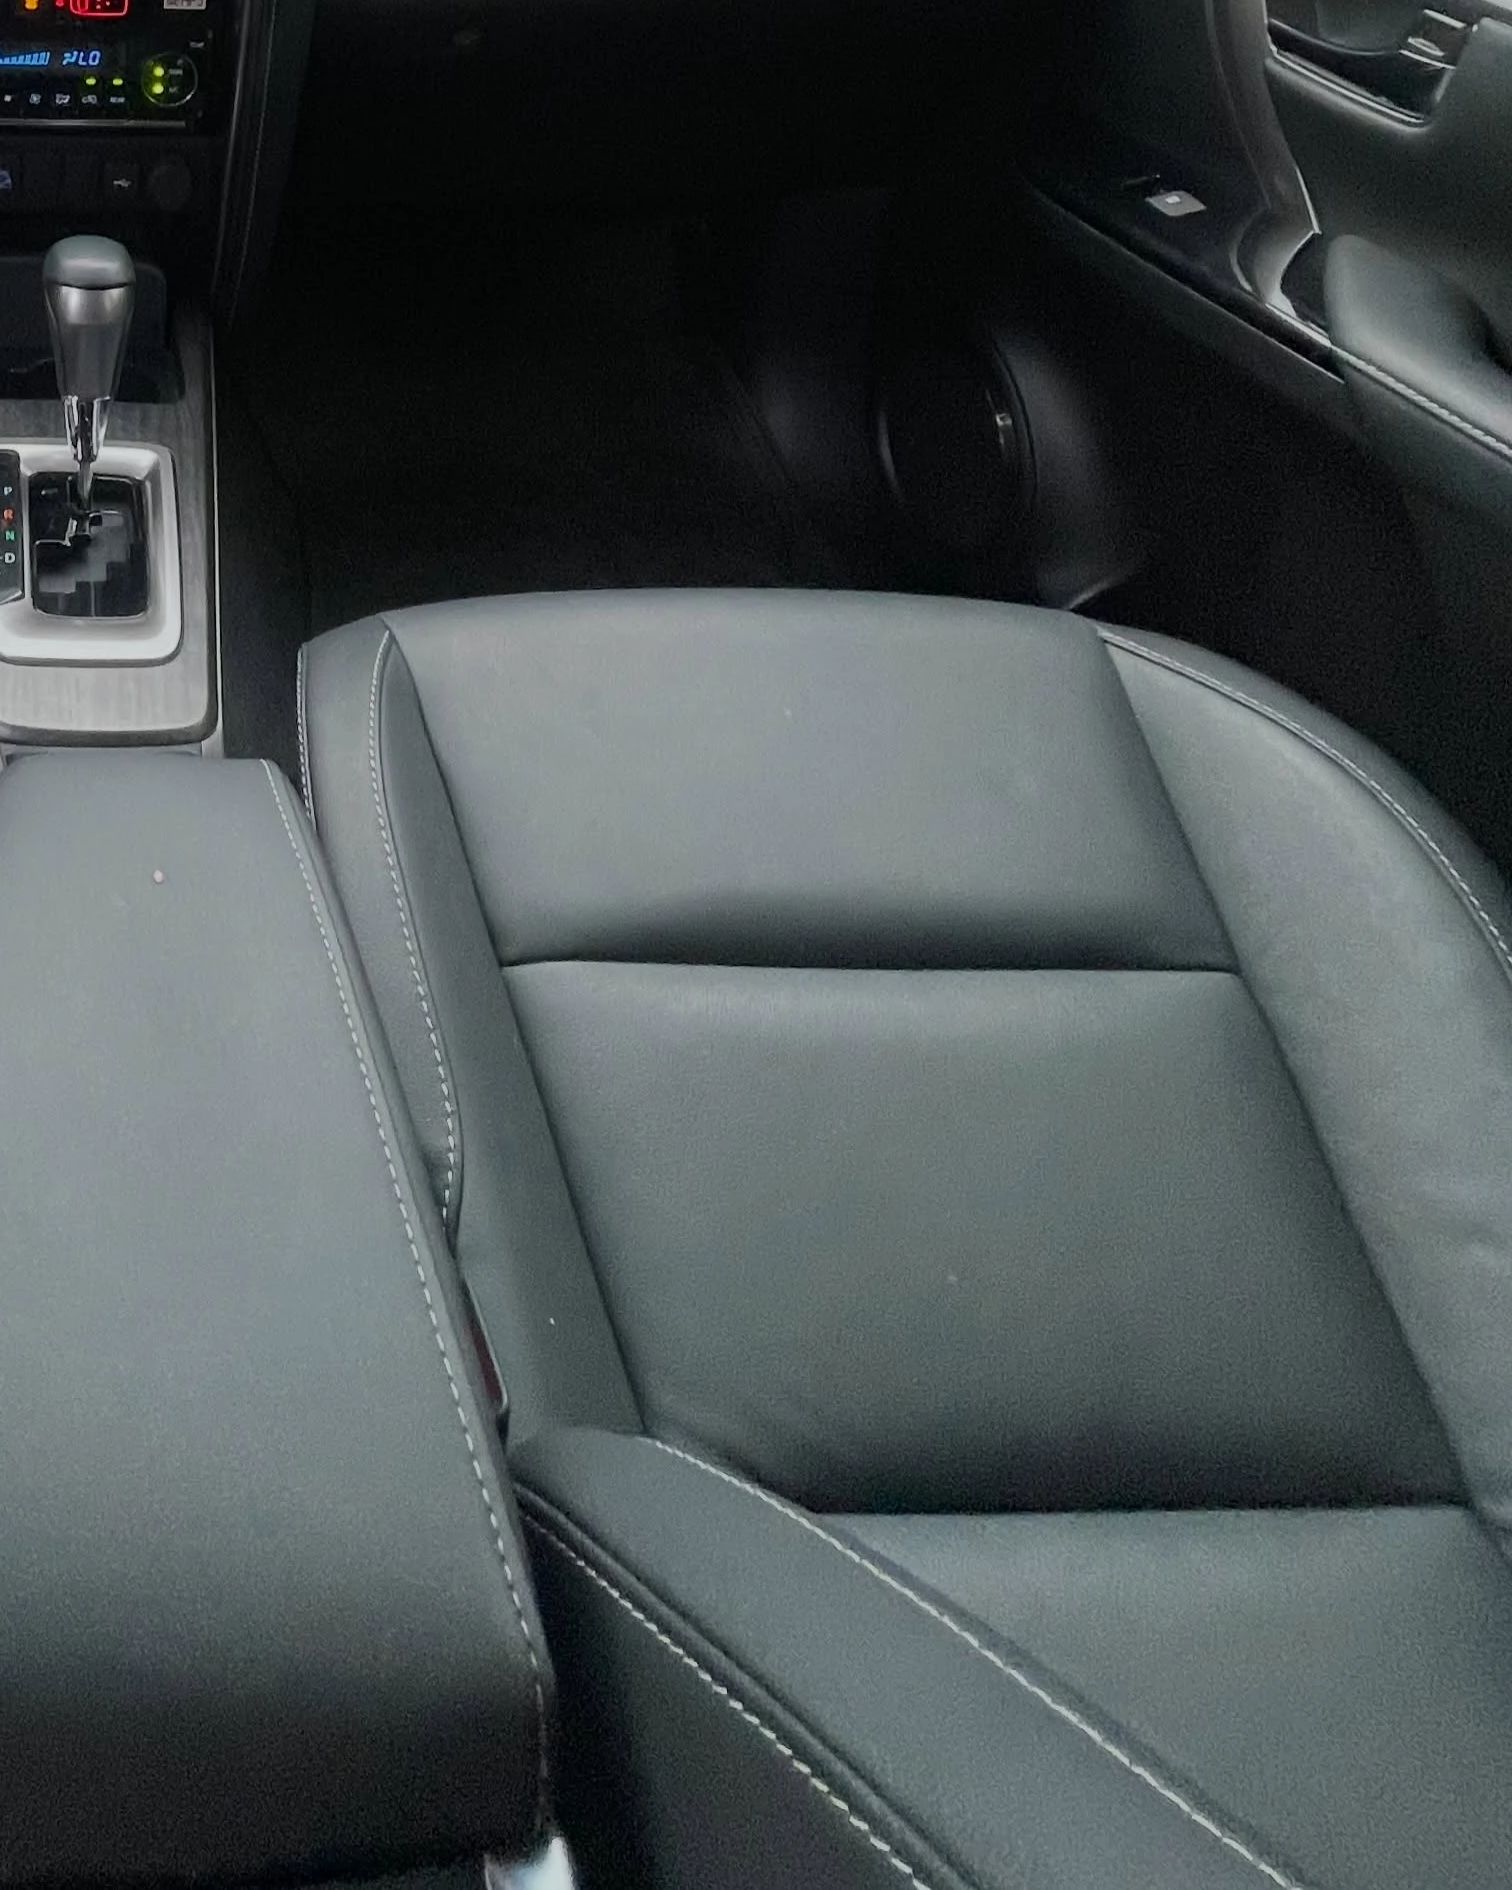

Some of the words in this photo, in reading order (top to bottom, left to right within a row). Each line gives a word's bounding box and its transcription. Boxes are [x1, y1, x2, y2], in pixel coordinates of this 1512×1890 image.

[77, 50, 101, 66] LO
[4, 486, 12, 495] P
[4, 510, 13, 519] R
[6, 531, 14, 540] N
